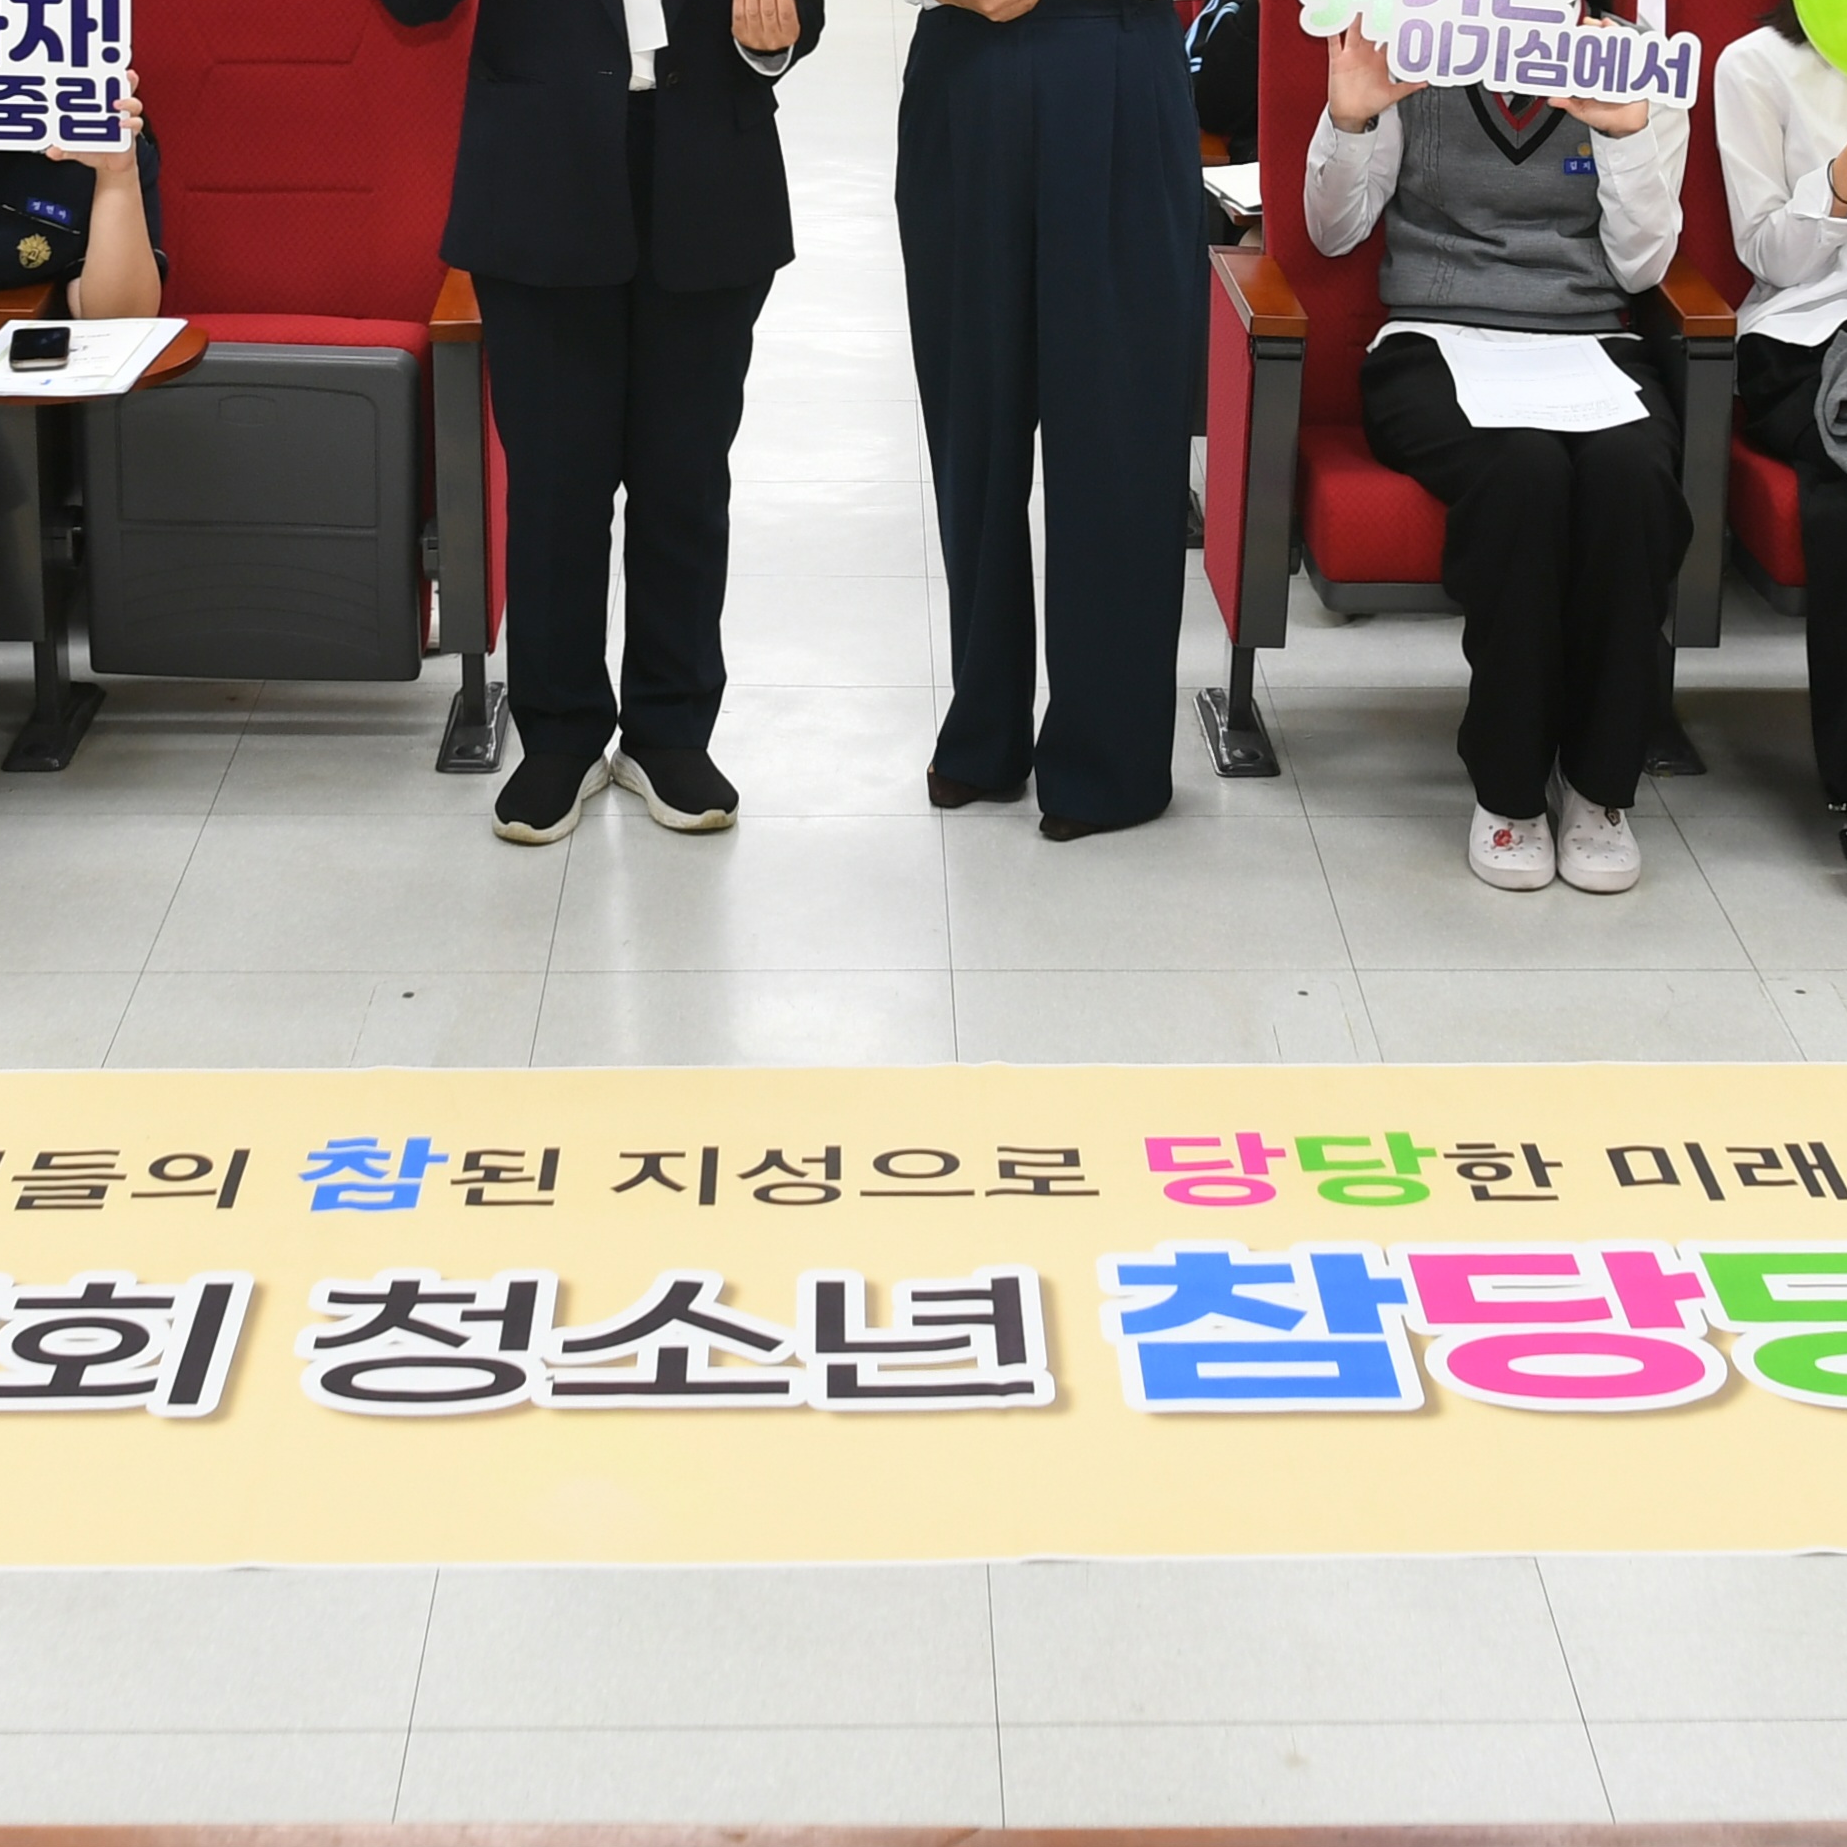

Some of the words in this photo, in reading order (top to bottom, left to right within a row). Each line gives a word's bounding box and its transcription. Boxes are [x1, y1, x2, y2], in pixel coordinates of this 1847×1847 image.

[1396, 18, 1692, 100] 이기심에서
[297, 1136, 564, 1210] 참된
[611, 1146, 1102, 1206] 지성으로
[1142, 1130, 1564, 1207] 당당한
[313, 1278, 1037, 1401] 청소년
